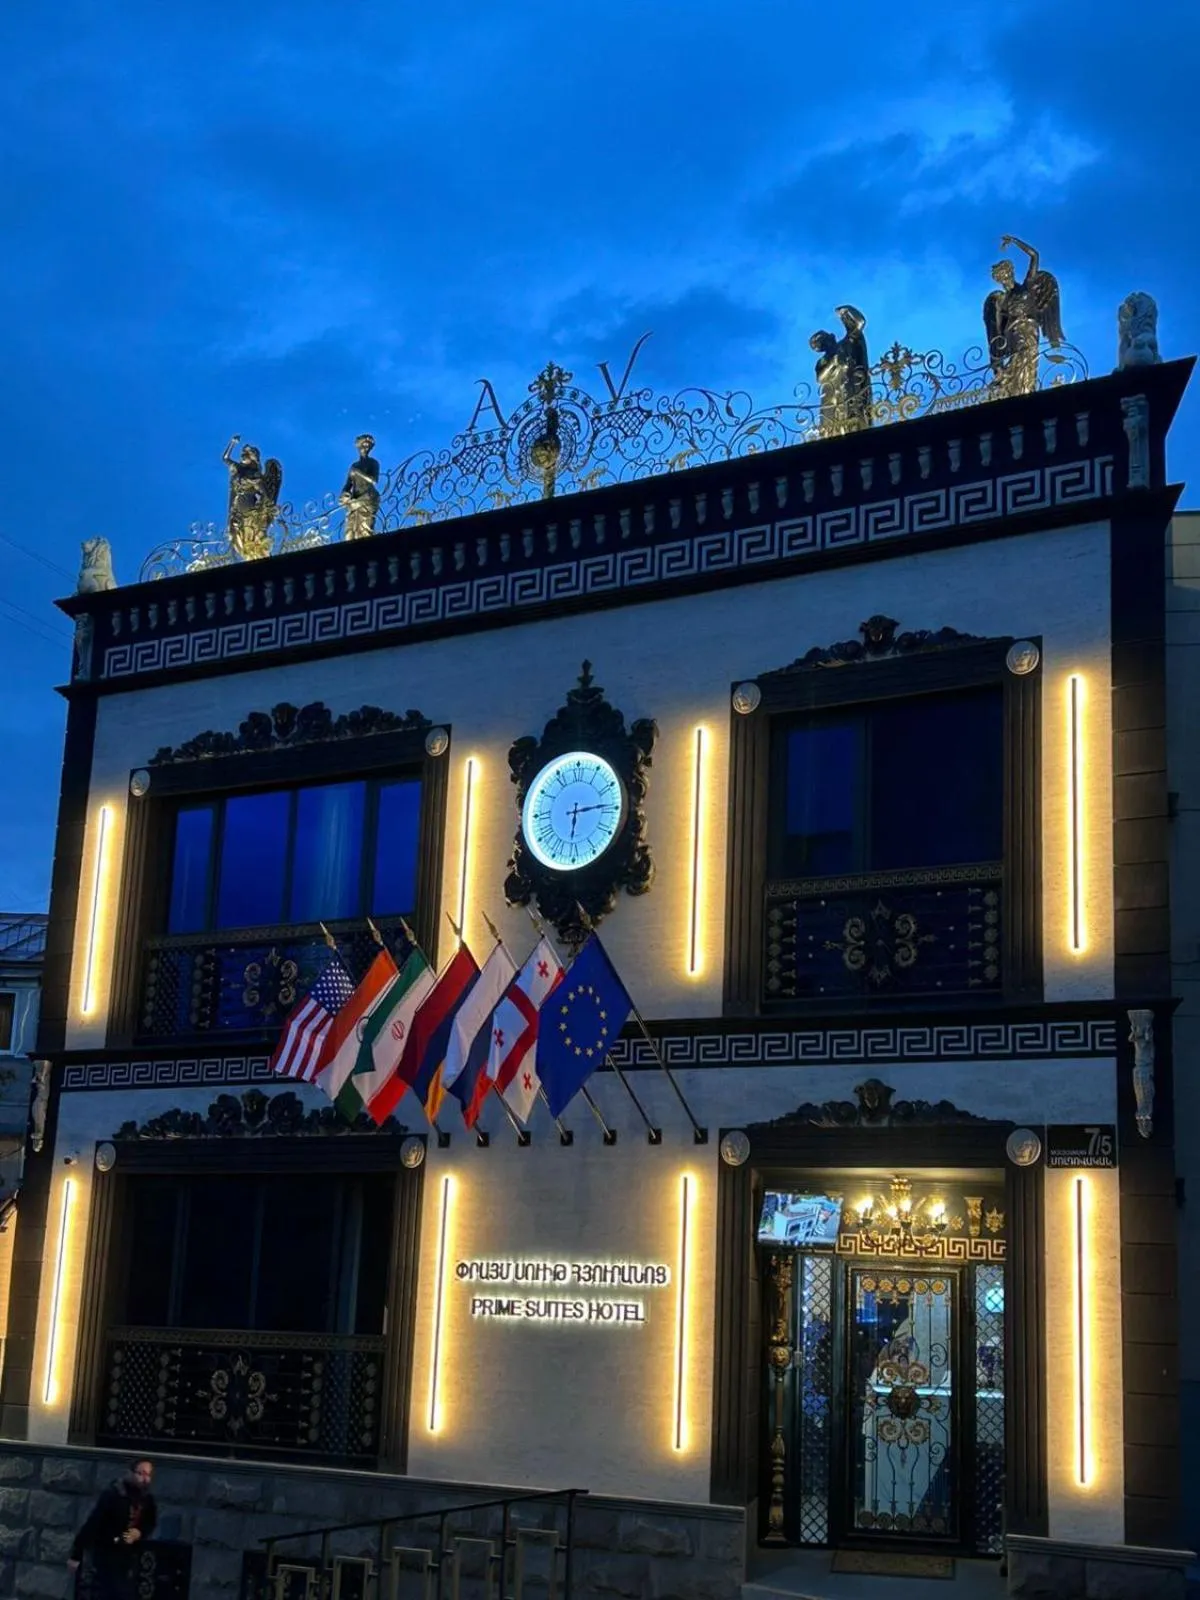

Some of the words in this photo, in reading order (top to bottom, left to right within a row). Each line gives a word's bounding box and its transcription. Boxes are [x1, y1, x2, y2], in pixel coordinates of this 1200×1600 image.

[455, 1262, 513, 1281] ՓՐԱՅՄ
[515, 1263, 567, 1282] ՍՈՒԻԹ
[572, 1264, 667, 1284] ՀՅՈՒՐԱՆՈՑ
[471, 1298, 522, 1317] PRIME
[525, 1299, 584, 1319] SUITES
[587, 1302, 645, 1321] HOTEL
